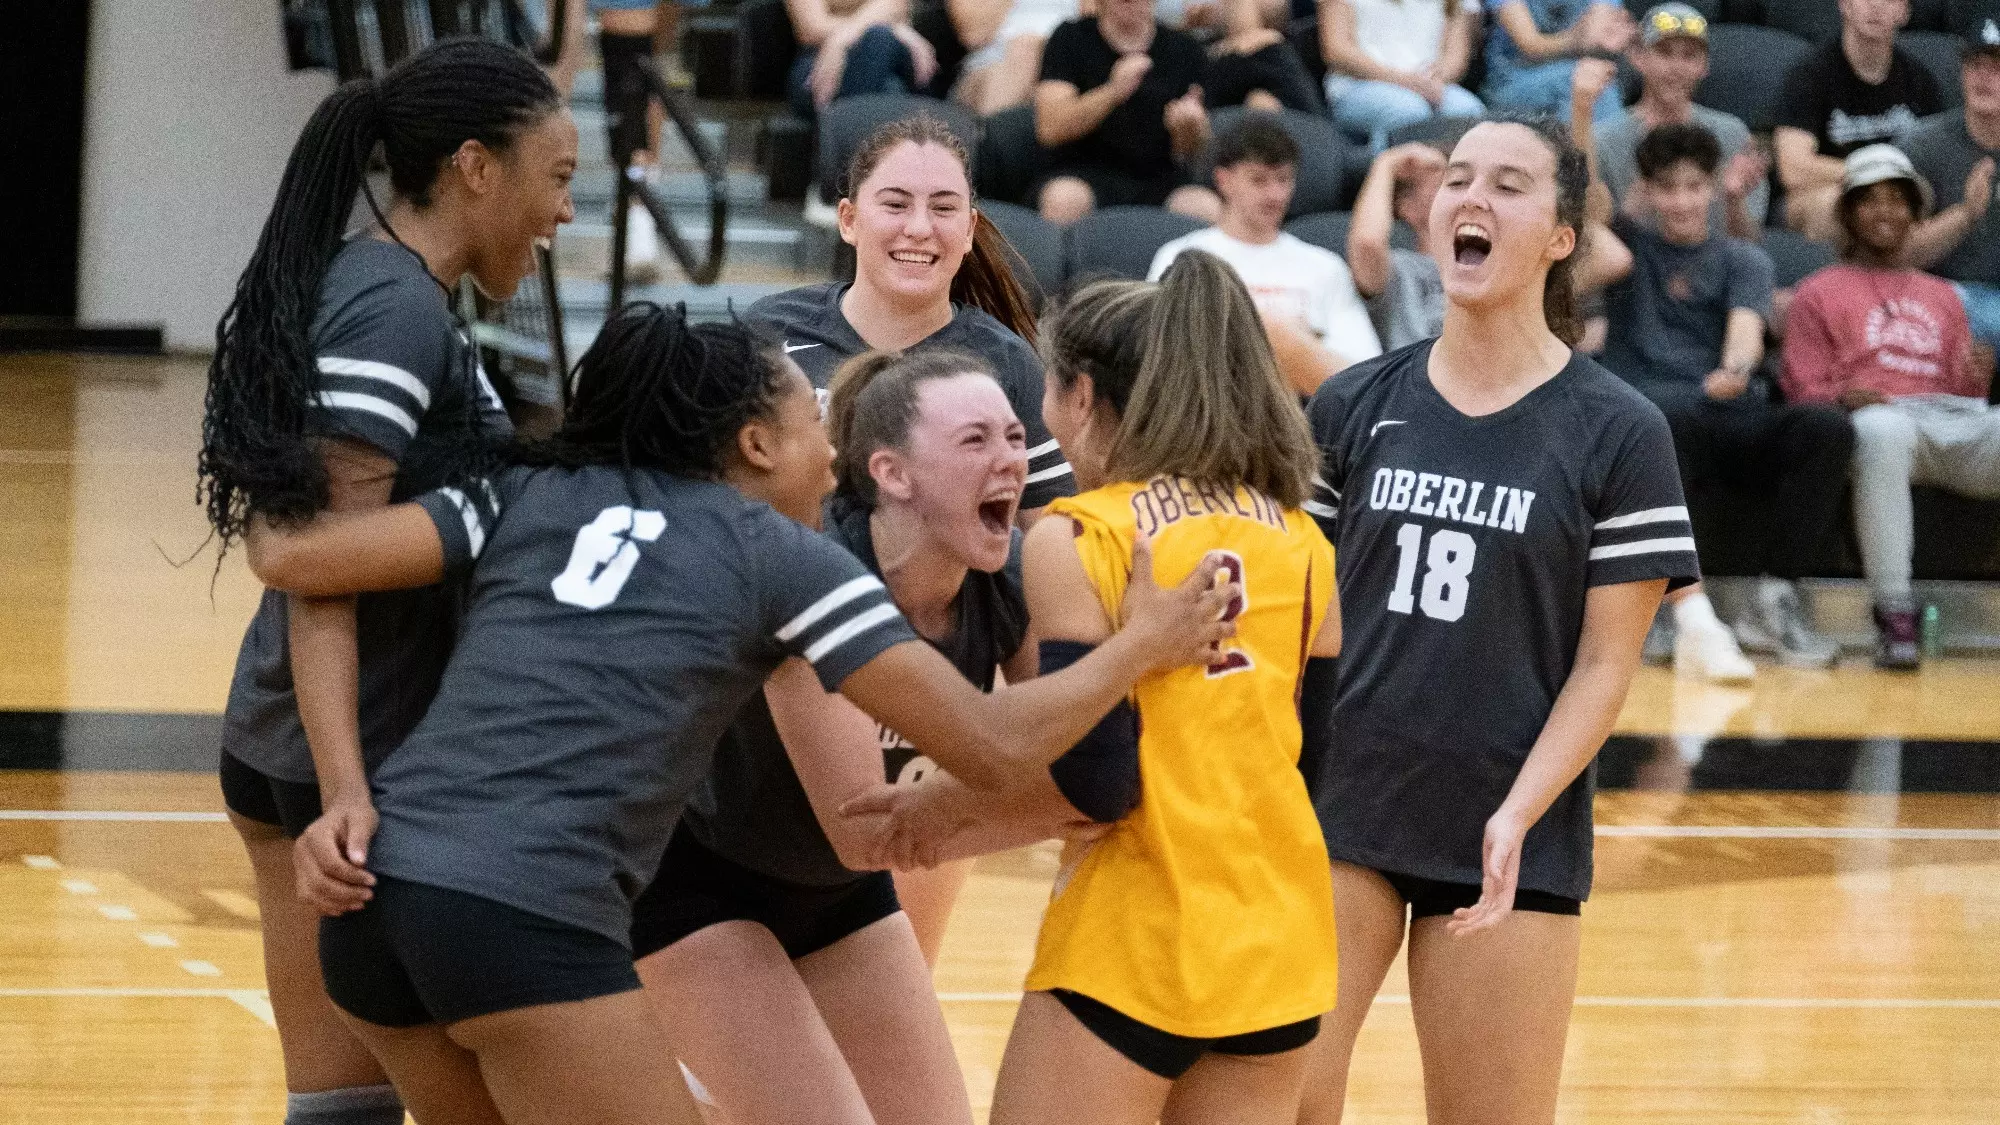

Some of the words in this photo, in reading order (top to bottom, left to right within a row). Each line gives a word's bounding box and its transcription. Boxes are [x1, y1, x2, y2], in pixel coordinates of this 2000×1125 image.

[1370, 467, 1536, 534] OBERLIN
[551, 505, 667, 609] 6
[1387, 522, 1477, 622] 18
